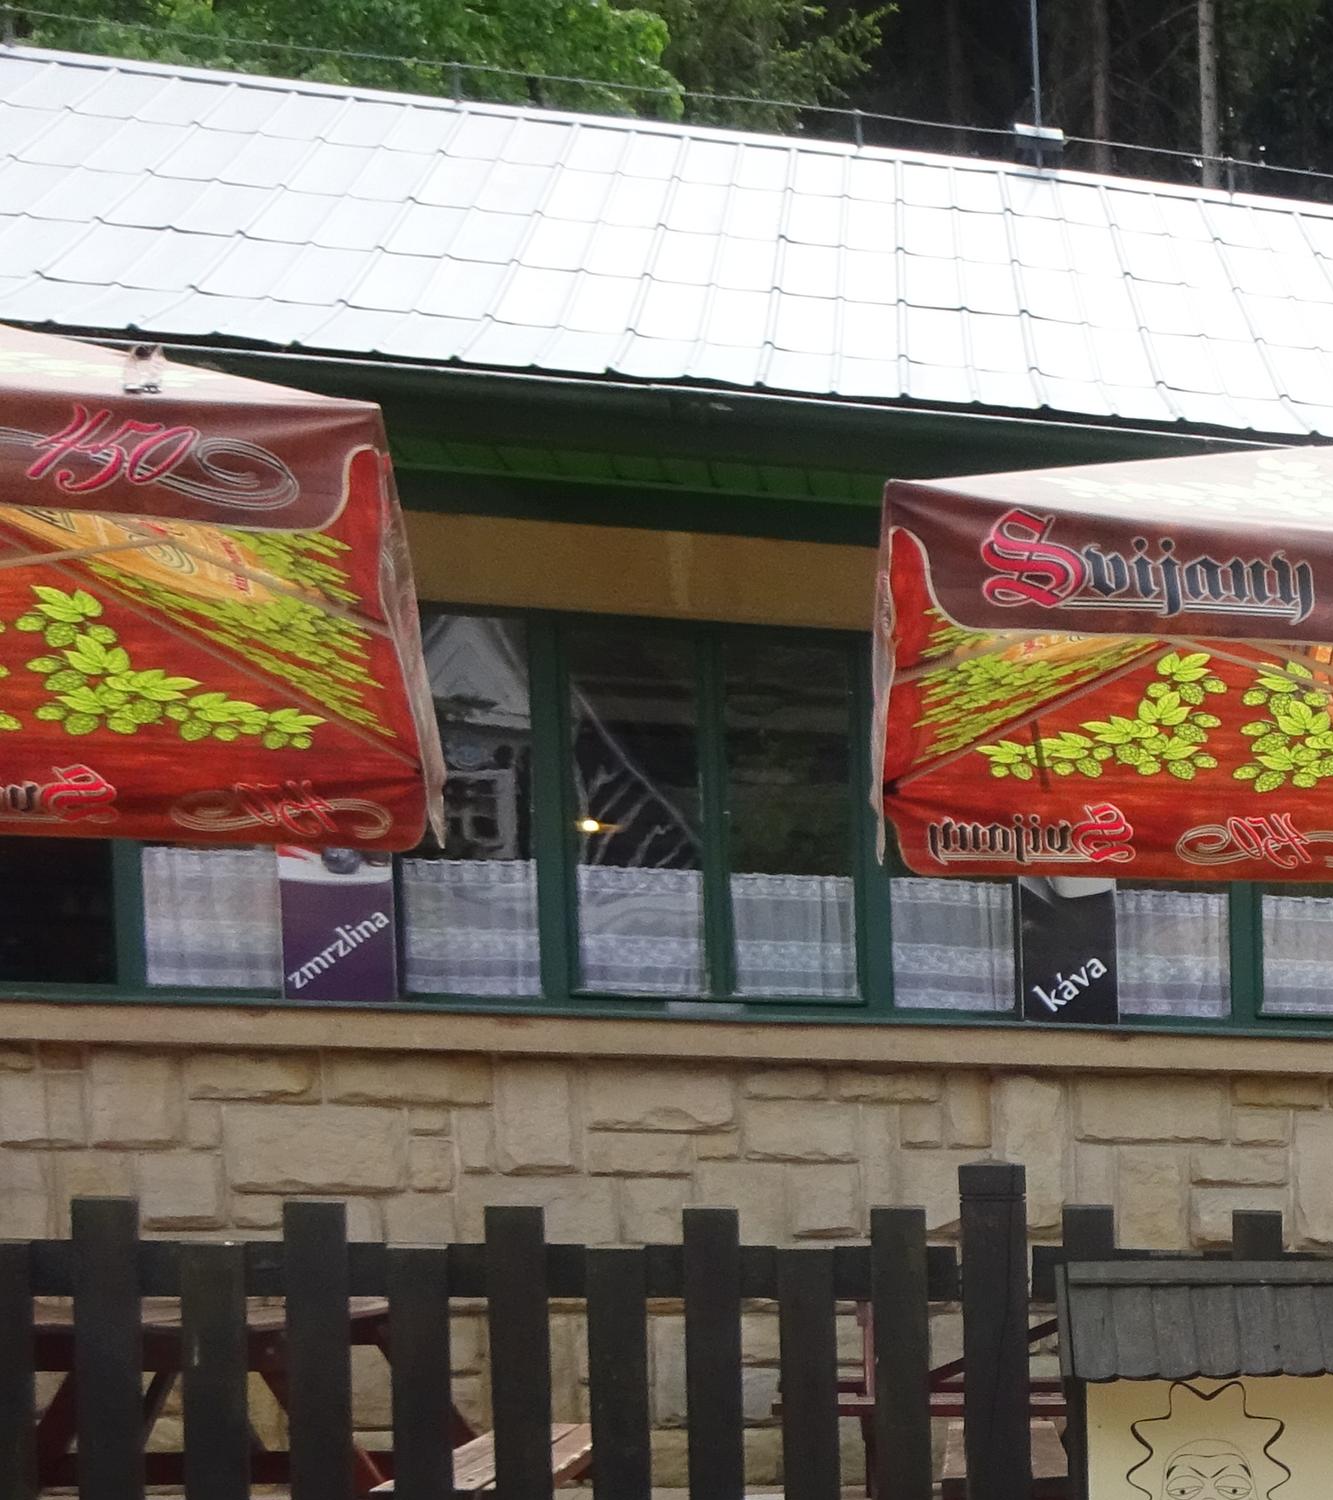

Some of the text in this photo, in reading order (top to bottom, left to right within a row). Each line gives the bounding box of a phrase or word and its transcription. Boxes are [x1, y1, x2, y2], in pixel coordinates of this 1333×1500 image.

[26, 404, 199, 494] 450
[980, 507, 1316, 625] Svijany
[287, 910, 391, 989] zmrzlina
[1030, 951, 1108, 1013] káva
